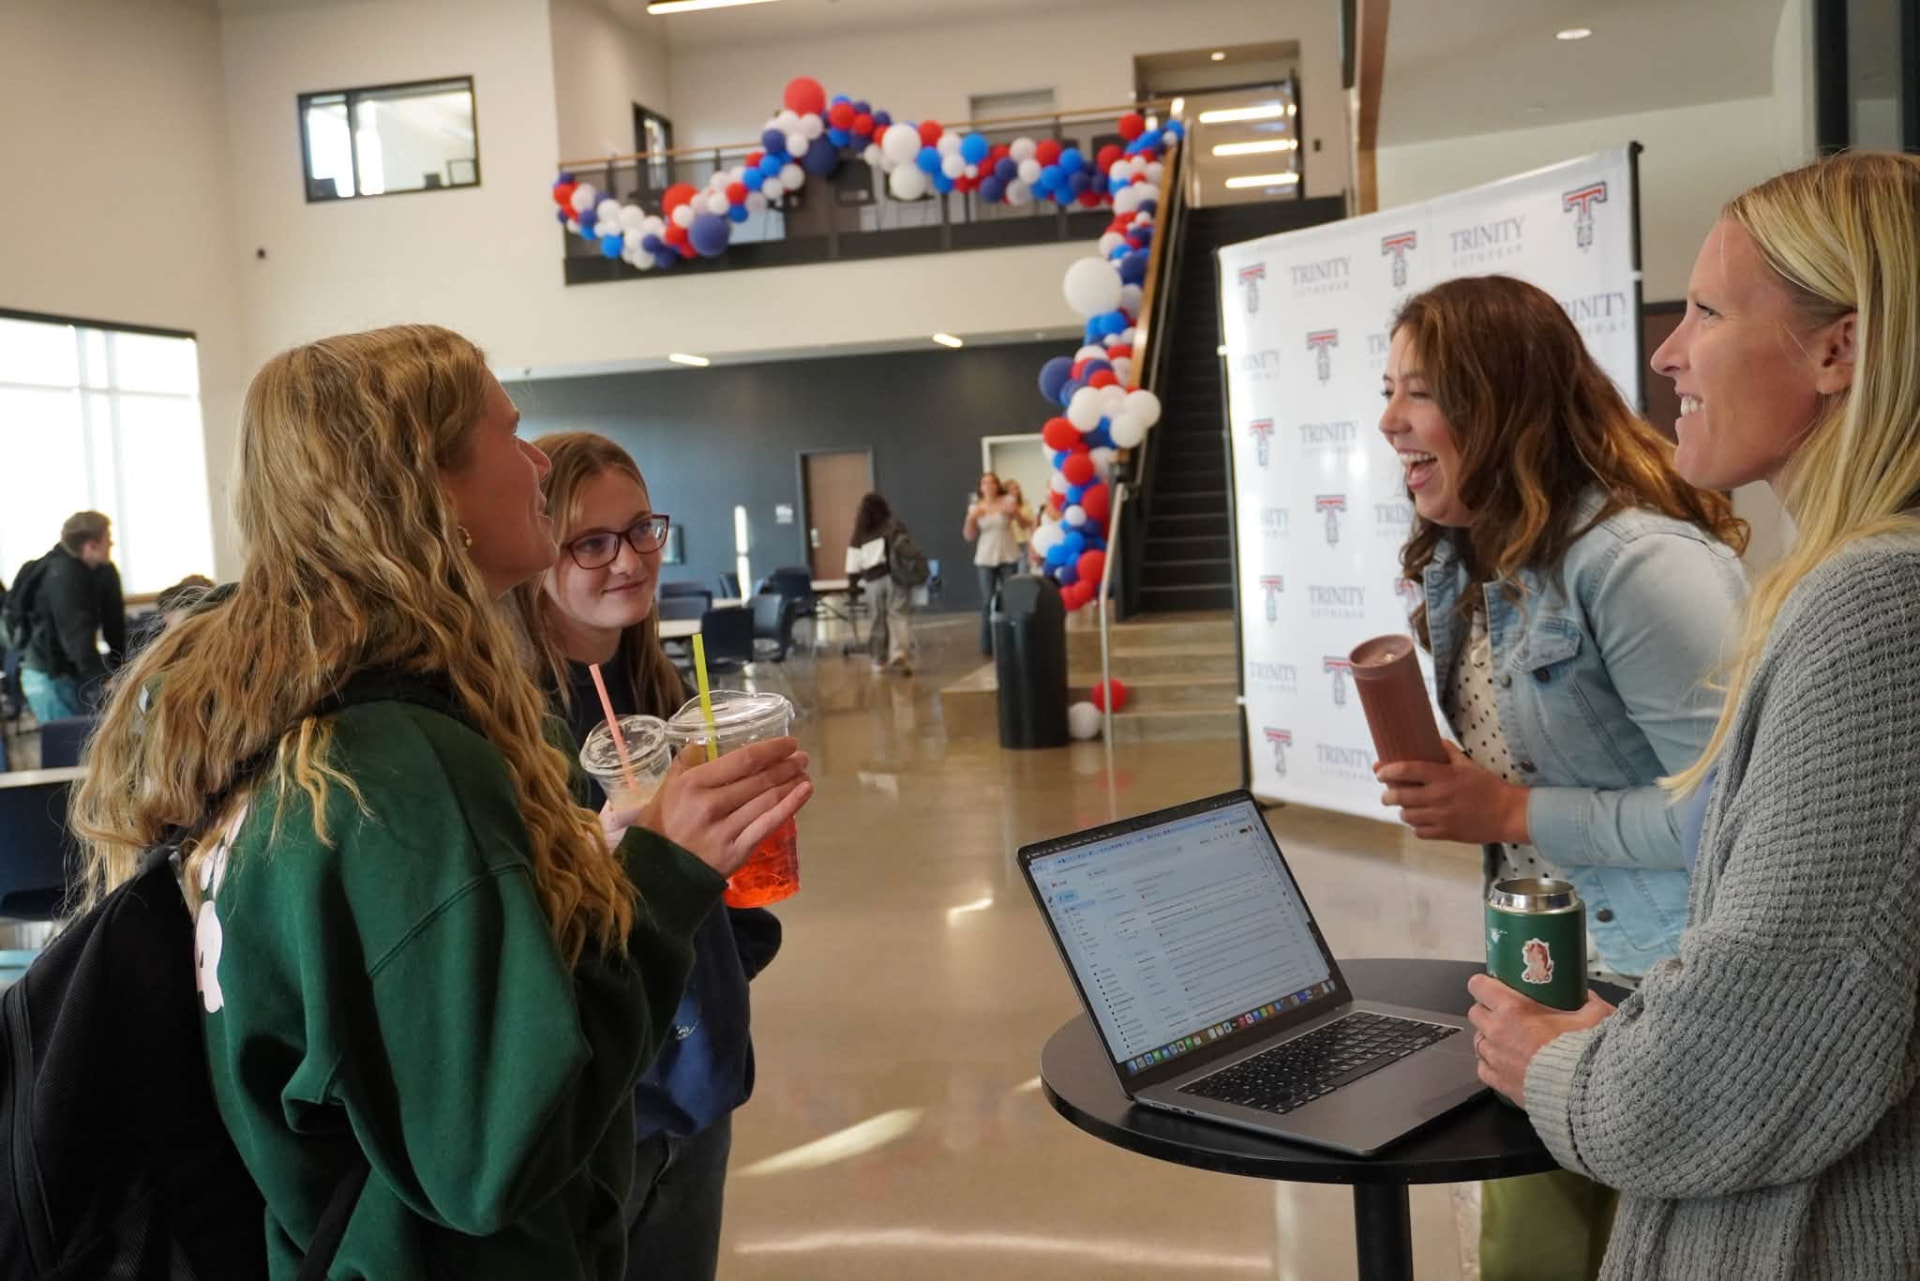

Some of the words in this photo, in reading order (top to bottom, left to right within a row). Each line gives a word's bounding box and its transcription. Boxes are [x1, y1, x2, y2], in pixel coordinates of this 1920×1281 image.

[1450, 215, 1525, 252] TRINITY
[1290, 257, 1351, 286] TRINITY
[1299, 420, 1358, 443] TRINITY
[1307, 586, 1365, 606] TRINITY
[1316, 743, 1374, 767] TRINITY
